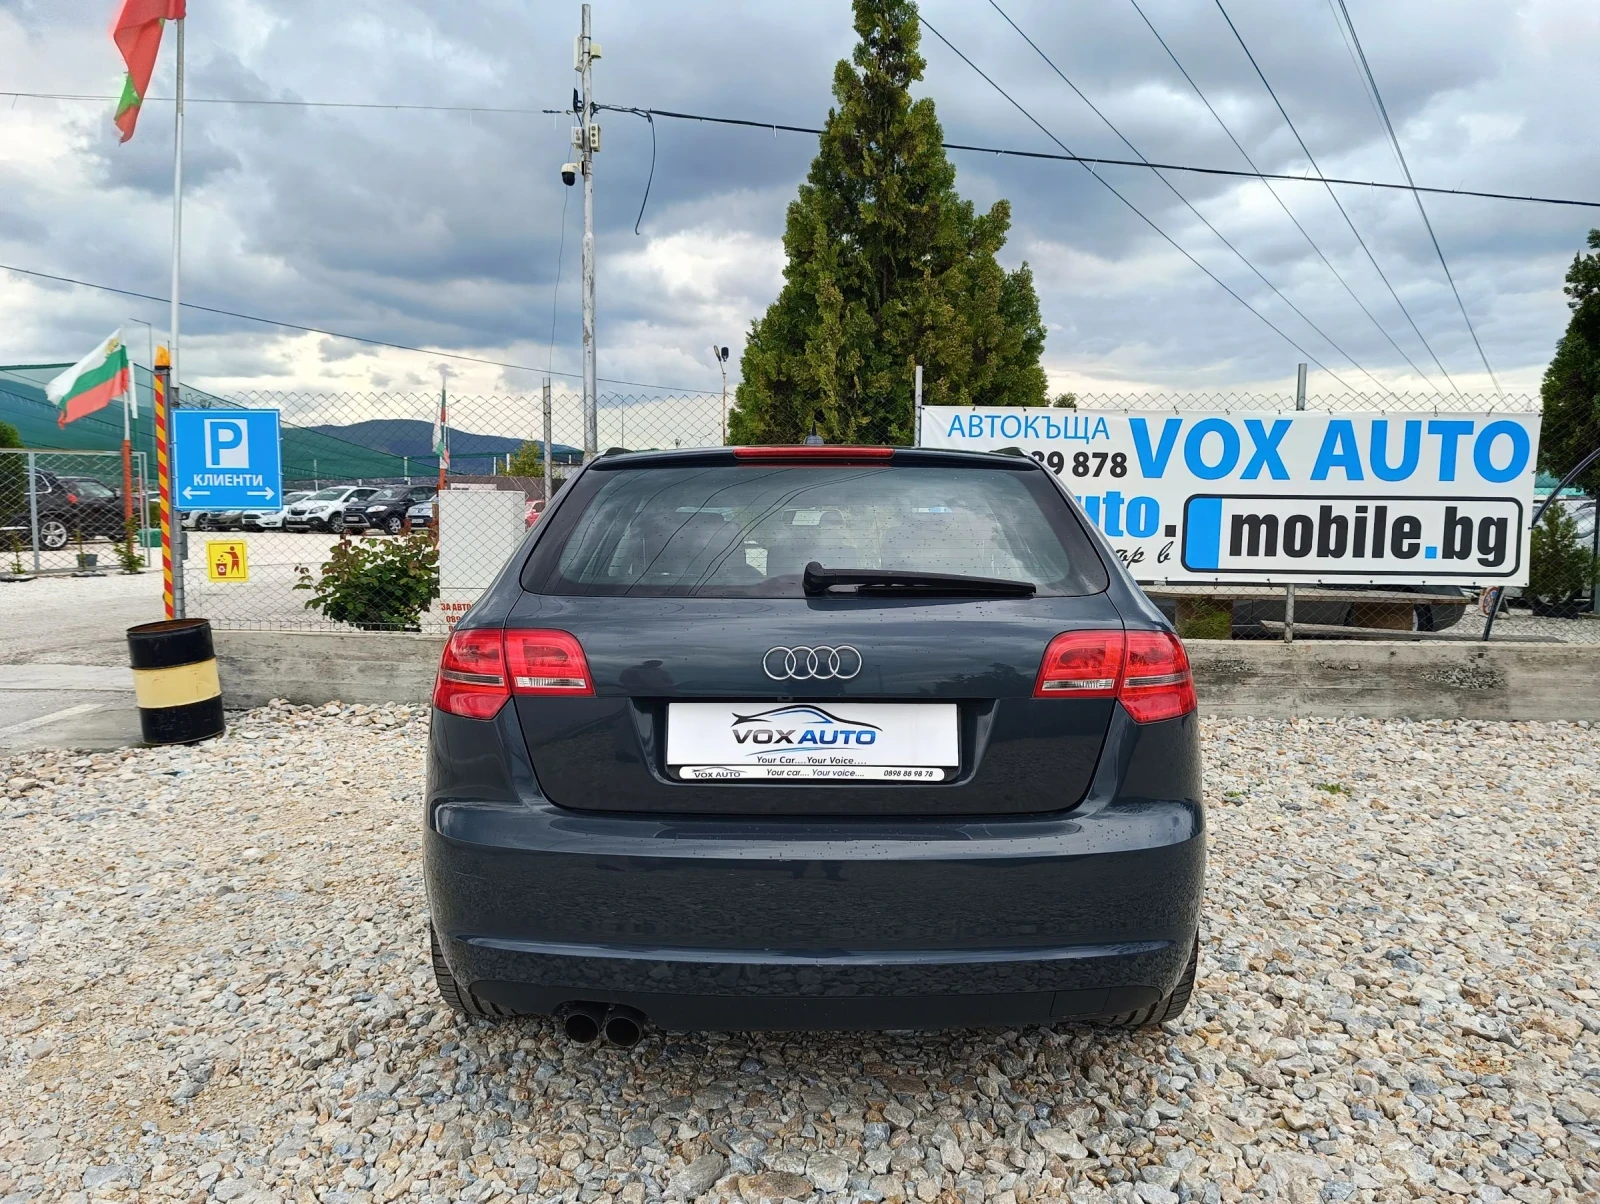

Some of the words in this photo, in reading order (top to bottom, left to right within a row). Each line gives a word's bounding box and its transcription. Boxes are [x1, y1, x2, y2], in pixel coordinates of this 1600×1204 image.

[947, 414, 1110, 445] АВТОКЪЩА
[210, 421, 243, 466] P
[1128, 417, 1290, 481] VOX
[1310, 419, 1530, 484] AUTO
[1071, 451, 1128, 478] 878
[193, 474, 263, 487] КЛИЕНТИ
[1229, 505, 1509, 568] mobile.bg
[452, 603, 473, 611] АВТО
[757, 756, 777, 764] Your
[766, 768, 785, 776] Your
[812, 768, 831, 777] Your
[883, 769, 902, 777] 0898
[913, 770, 923, 778] 98
[924, 770, 934, 778] 78
